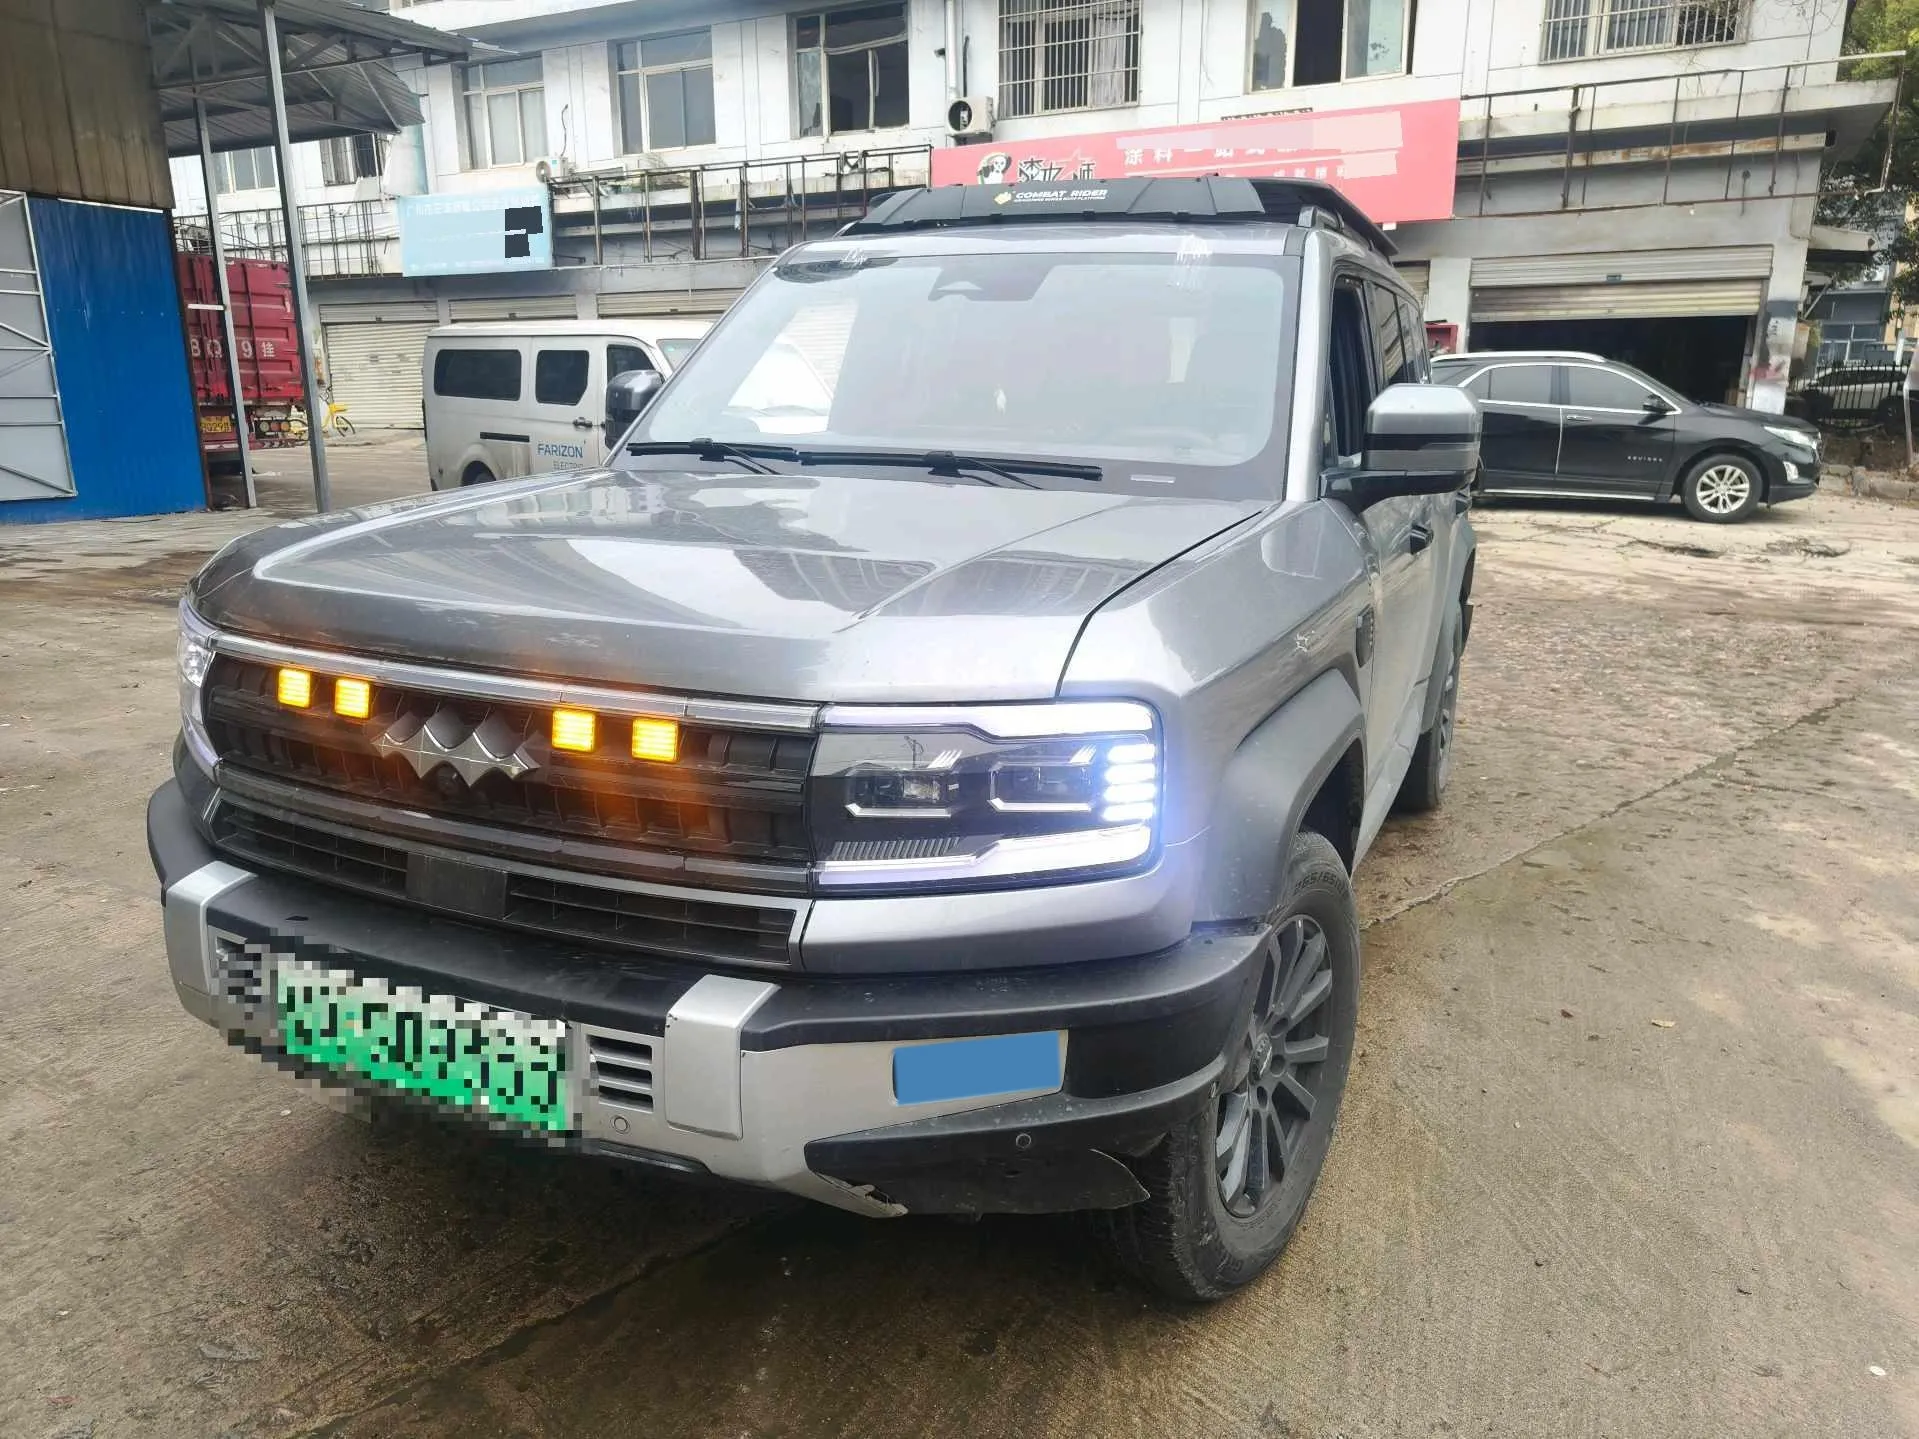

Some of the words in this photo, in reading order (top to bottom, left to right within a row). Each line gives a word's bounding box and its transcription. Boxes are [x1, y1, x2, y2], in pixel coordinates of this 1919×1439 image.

[1015, 190, 1067, 199] COMBAT
[1070, 189, 1108, 197] RIDER
[537, 443, 583, 459] FARIZON
